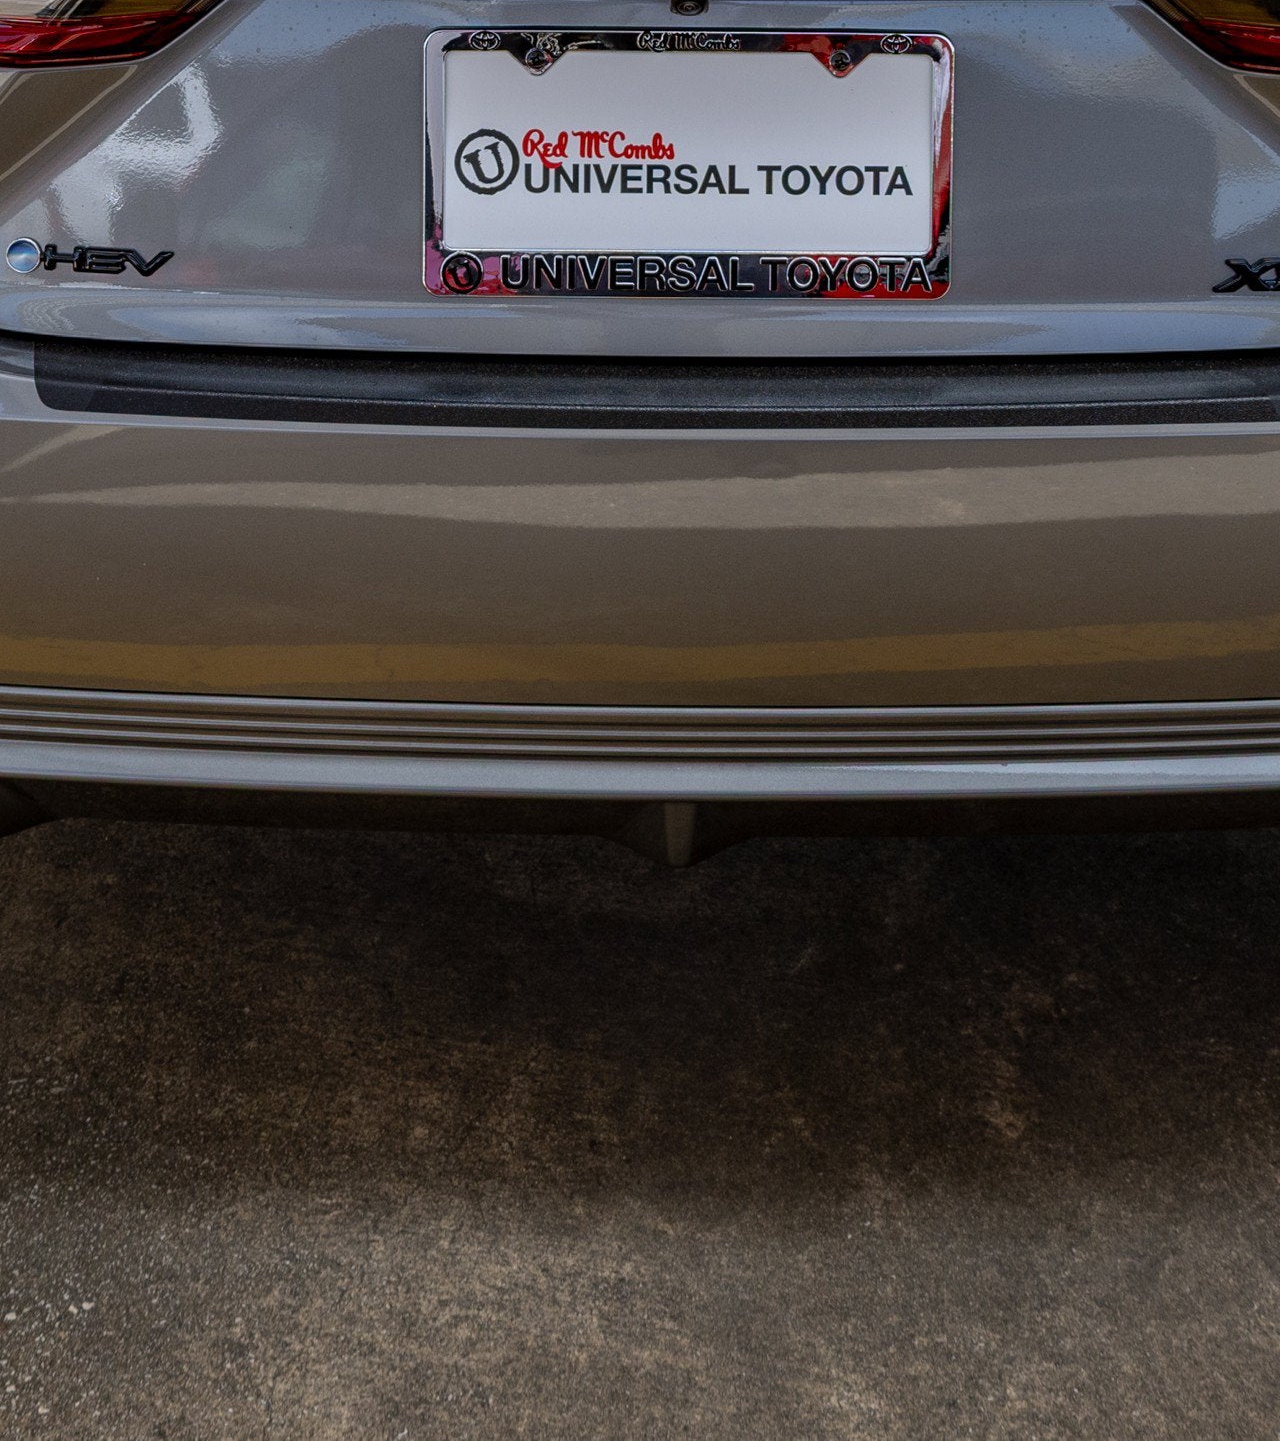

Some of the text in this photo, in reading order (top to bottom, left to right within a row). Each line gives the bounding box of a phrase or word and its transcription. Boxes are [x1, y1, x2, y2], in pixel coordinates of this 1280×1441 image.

[636, 30, 669, 53] Red
[522, 128, 676, 170] Red McCombs
[523, 162, 914, 196] UNIVERSAL TOYOTA
[43, 244, 175, 277] HEV
[499, 254, 754, 292] UNIVERSAL
[759, 254, 933, 293] TOYOTA
